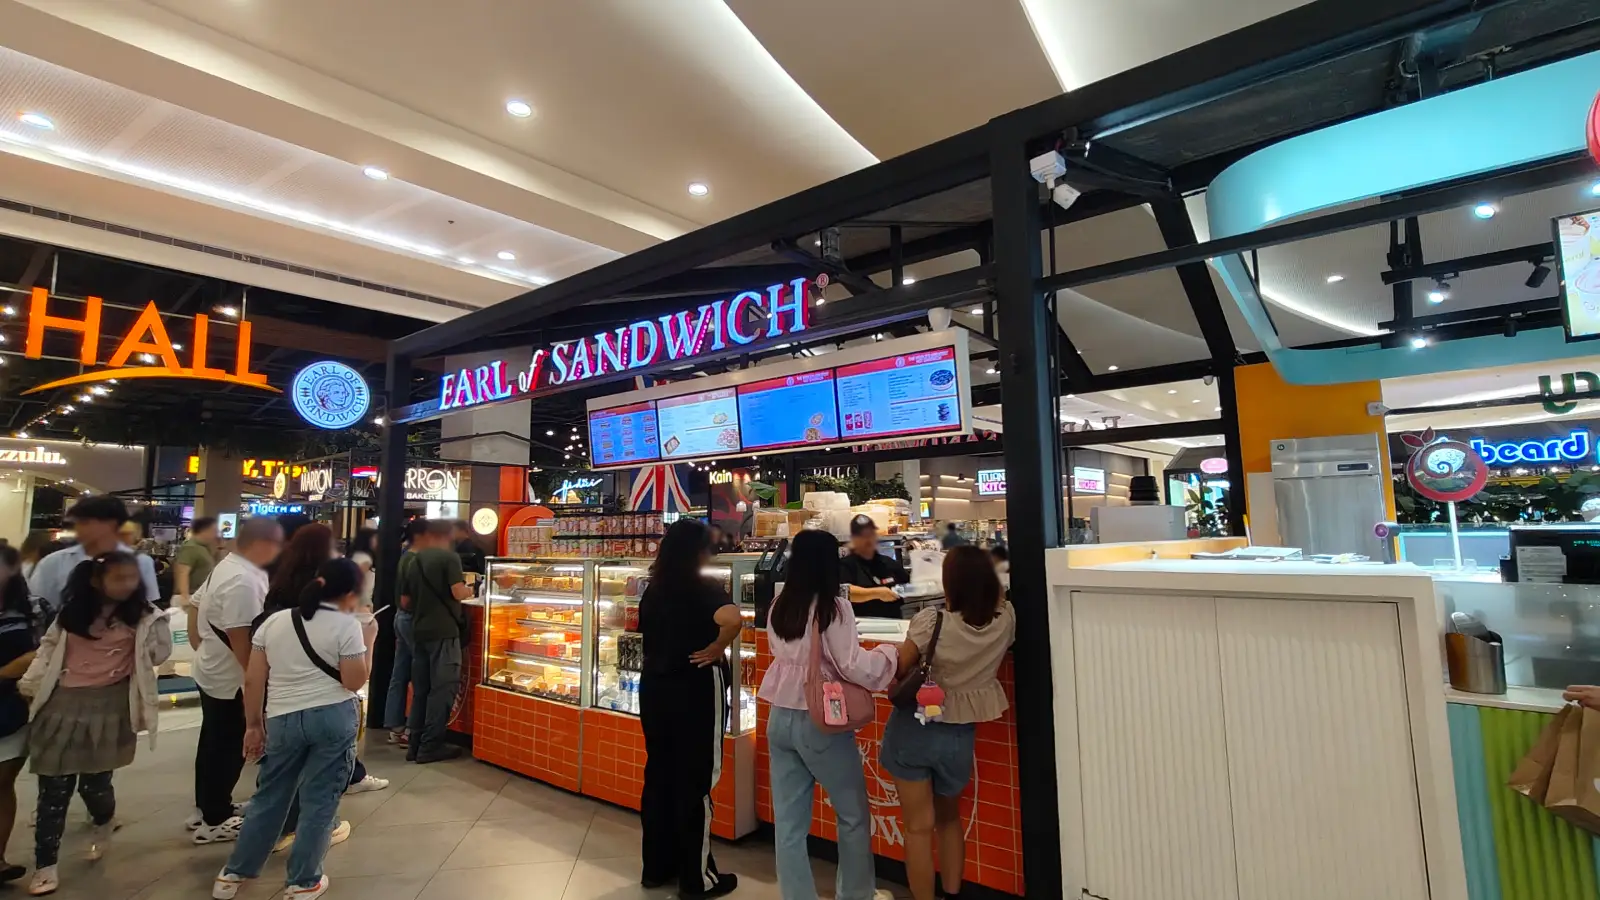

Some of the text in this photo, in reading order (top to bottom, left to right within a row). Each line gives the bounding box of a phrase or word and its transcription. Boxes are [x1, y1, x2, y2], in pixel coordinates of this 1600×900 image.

[25, 287, 268, 384] HALL
[439, 361, 511, 411] EARL
[518, 349, 547, 393] of
[548, 277, 809, 386] SANDWICH
[303, 366, 361, 387] EARL OF
[302, 397, 366, 422] SANDWICH
[301, 468, 332, 494] MARRON
[709, 469, 732, 484] Kain
